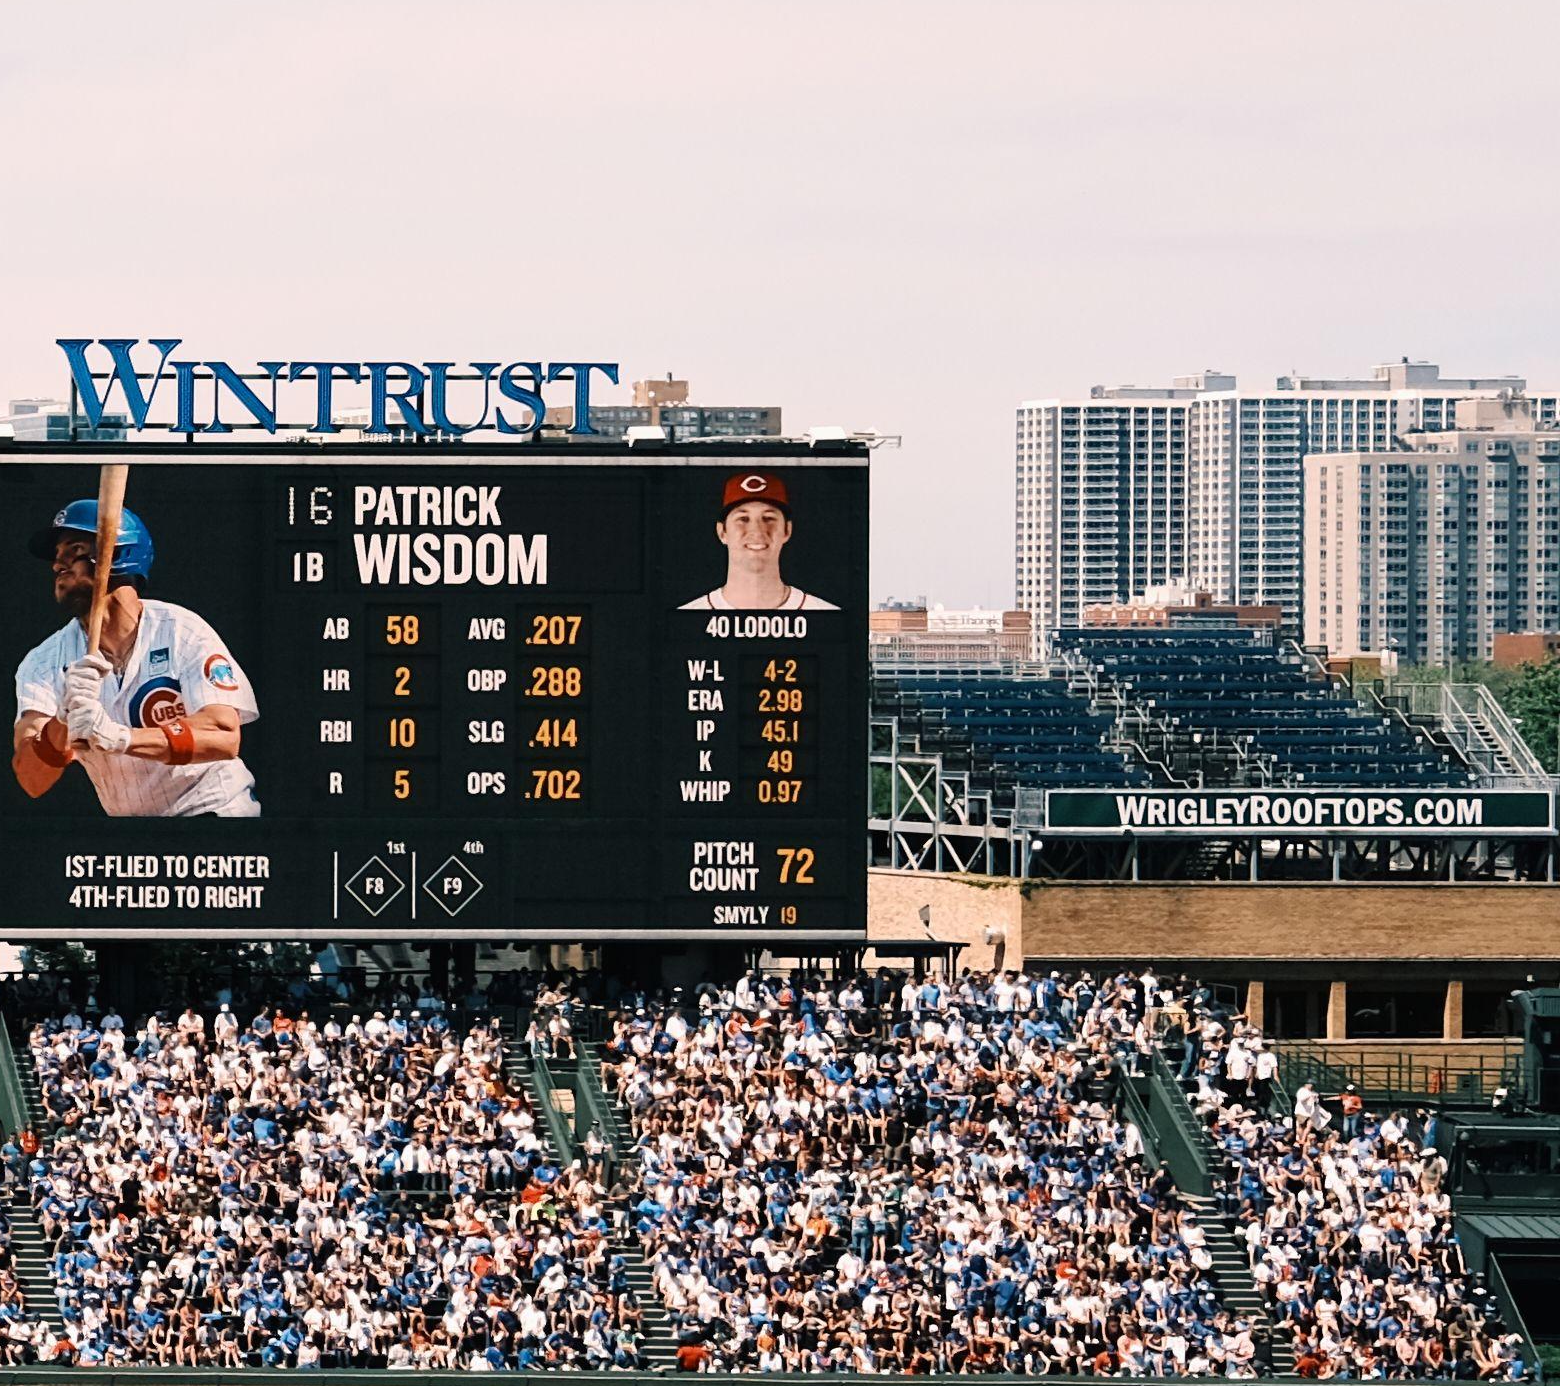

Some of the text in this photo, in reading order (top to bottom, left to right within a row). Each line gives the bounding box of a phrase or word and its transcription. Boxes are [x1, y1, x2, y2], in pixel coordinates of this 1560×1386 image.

[55, 338, 619, 435] WINTRUST
[288, 486, 502, 526] 16 PATRICK
[293, 533, 548, 585] 1B WISDOM
[323, 615, 582, 645] AB 58 AVG .207
[706, 616, 807, 638] 40 LODOLO
[323, 666, 581, 697] HR 2 OBP .288
[687, 660, 797, 682] W-L 4-2
[687, 689, 803, 712] ERA 2.98
[320, 718, 577, 748] RBI 10 SLG .414
[696, 720, 799, 742] IP 45.1
[699, 750, 793, 772] K 49
[329, 770, 581, 799] R 5 OPS .702
[680, 780, 803, 803] WHIP 0.97
[386, 841, 484, 854] 1st 4th
[694, 842, 754, 864] PITCH
[65, 856, 270, 878] 1ST-FLIED TO CENTER
[689, 848, 815, 891] COUNT 72
[69, 886, 264, 908] 4TH-FLIED TO RIGHT
[365, 877, 462, 895] F8 F9
[713, 906, 797, 924] SMYLY 19
